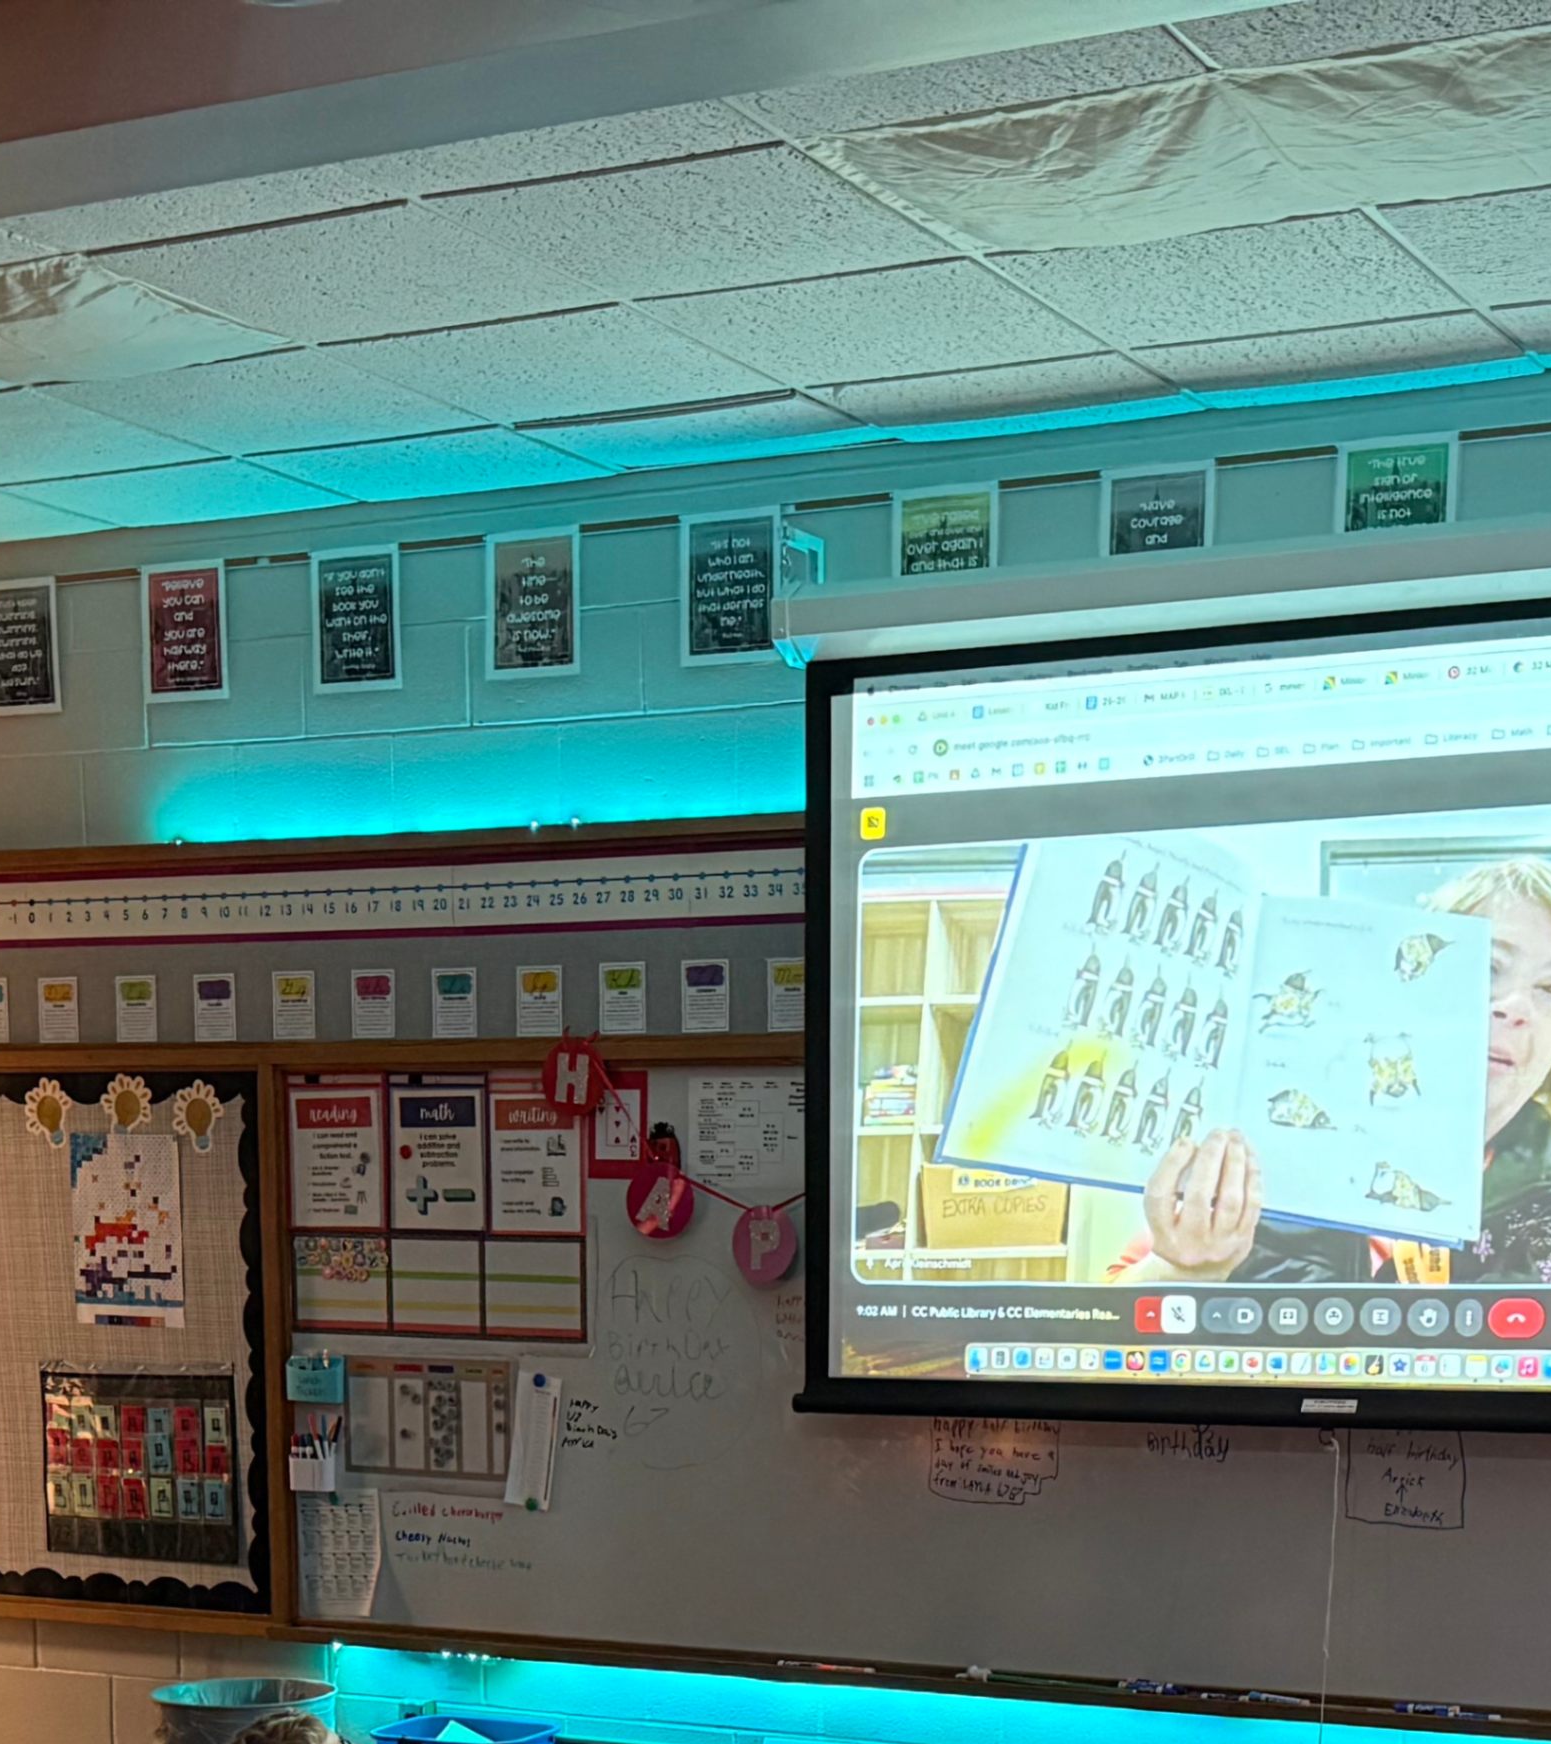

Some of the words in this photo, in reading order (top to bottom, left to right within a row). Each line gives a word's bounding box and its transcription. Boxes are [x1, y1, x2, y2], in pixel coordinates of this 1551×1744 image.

[309, 1105, 358, 1127] reading
[419, 1103, 455, 1122] math
[508, 1105, 558, 1127] writing
[554, 1052, 589, 1104] H
[635, 1176, 672, 1230] A
[749, 1220, 779, 1270] P
[942, 1197, 986, 1218] EXTRA
[994, 1195, 1046, 1214] COPIES
[911, 1306, 928, 1318] CC
[930, 1306, 959, 1318] Public
[961, 1306, 996, 1321] Library
[1007, 1307, 1023, 1319] CC
